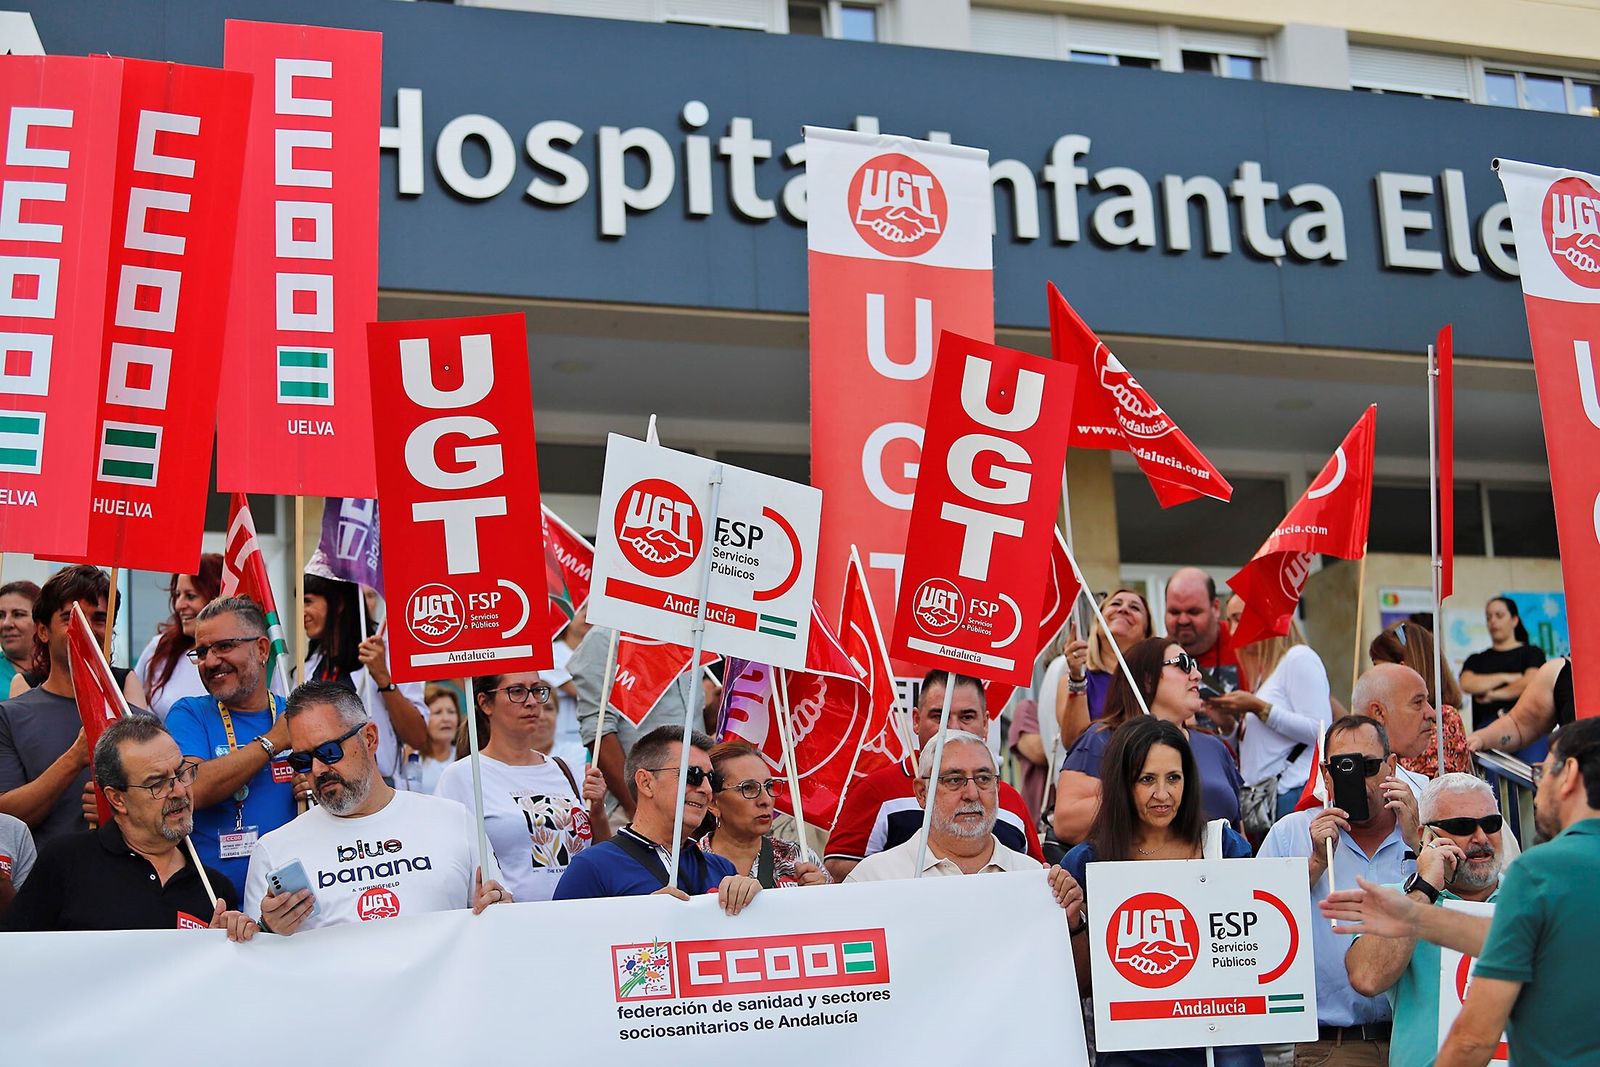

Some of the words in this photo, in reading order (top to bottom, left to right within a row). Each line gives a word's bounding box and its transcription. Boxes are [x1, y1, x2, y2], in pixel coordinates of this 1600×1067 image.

[380, 87, 880, 238] Hospit
[929, 131, 1348, 262] nfanta
[1376, 168, 1521, 278] Ele
[860, 168, 934, 218] UGT
[275, 58, 334, 333] CCOO
[105, 109, 200, 410] CCOO
[287, 419, 335, 436] UELVA
[399, 333, 508, 576] UGT
[940, 354, 1046, 582] UGT
[0, 488, 38, 507] ELVA
[92, 497, 153, 519] HUELVA
[624, 490, 693, 542] UGT
[712, 546, 760, 568] Servicios
[710, 561, 756, 581] Públicos
[413, 593, 455, 620] UGT
[468, 592, 502, 611] FSP
[663, 594, 737, 625] Andaucía
[920, 586, 958, 614] UGT
[969, 598, 1000, 619] FSP
[470, 613, 499, 621] Servicios
[471, 621, 500, 629] Públicos
[967, 617, 993, 628] Servicios
[966, 623, 992, 636] Públicos
[273, 766, 295, 776] CCO
[336, 838, 403, 863] blue
[318, 856, 432, 889] banana
[362, 893, 396, 912] UGT
[1116, 908, 1187, 945] UGT
[1211, 941, 1260, 954] Servicios
[687, 944, 838, 986] CCOO
[1212, 956, 1257, 969] Públicos
[617, 1000, 707, 1020] federación
[712, 999, 733, 1013] de
[738, 993, 803, 1012] sanidad
[808, 996, 817, 1009] y
[822, 988, 891, 1006] sectores
[1171, 998, 1247, 1017] Andalucía
[619, 1018, 749, 1041] sociosanitarios
[753, 1016, 775, 1031] de
[778, 1009, 859, 1030] Andalucía
